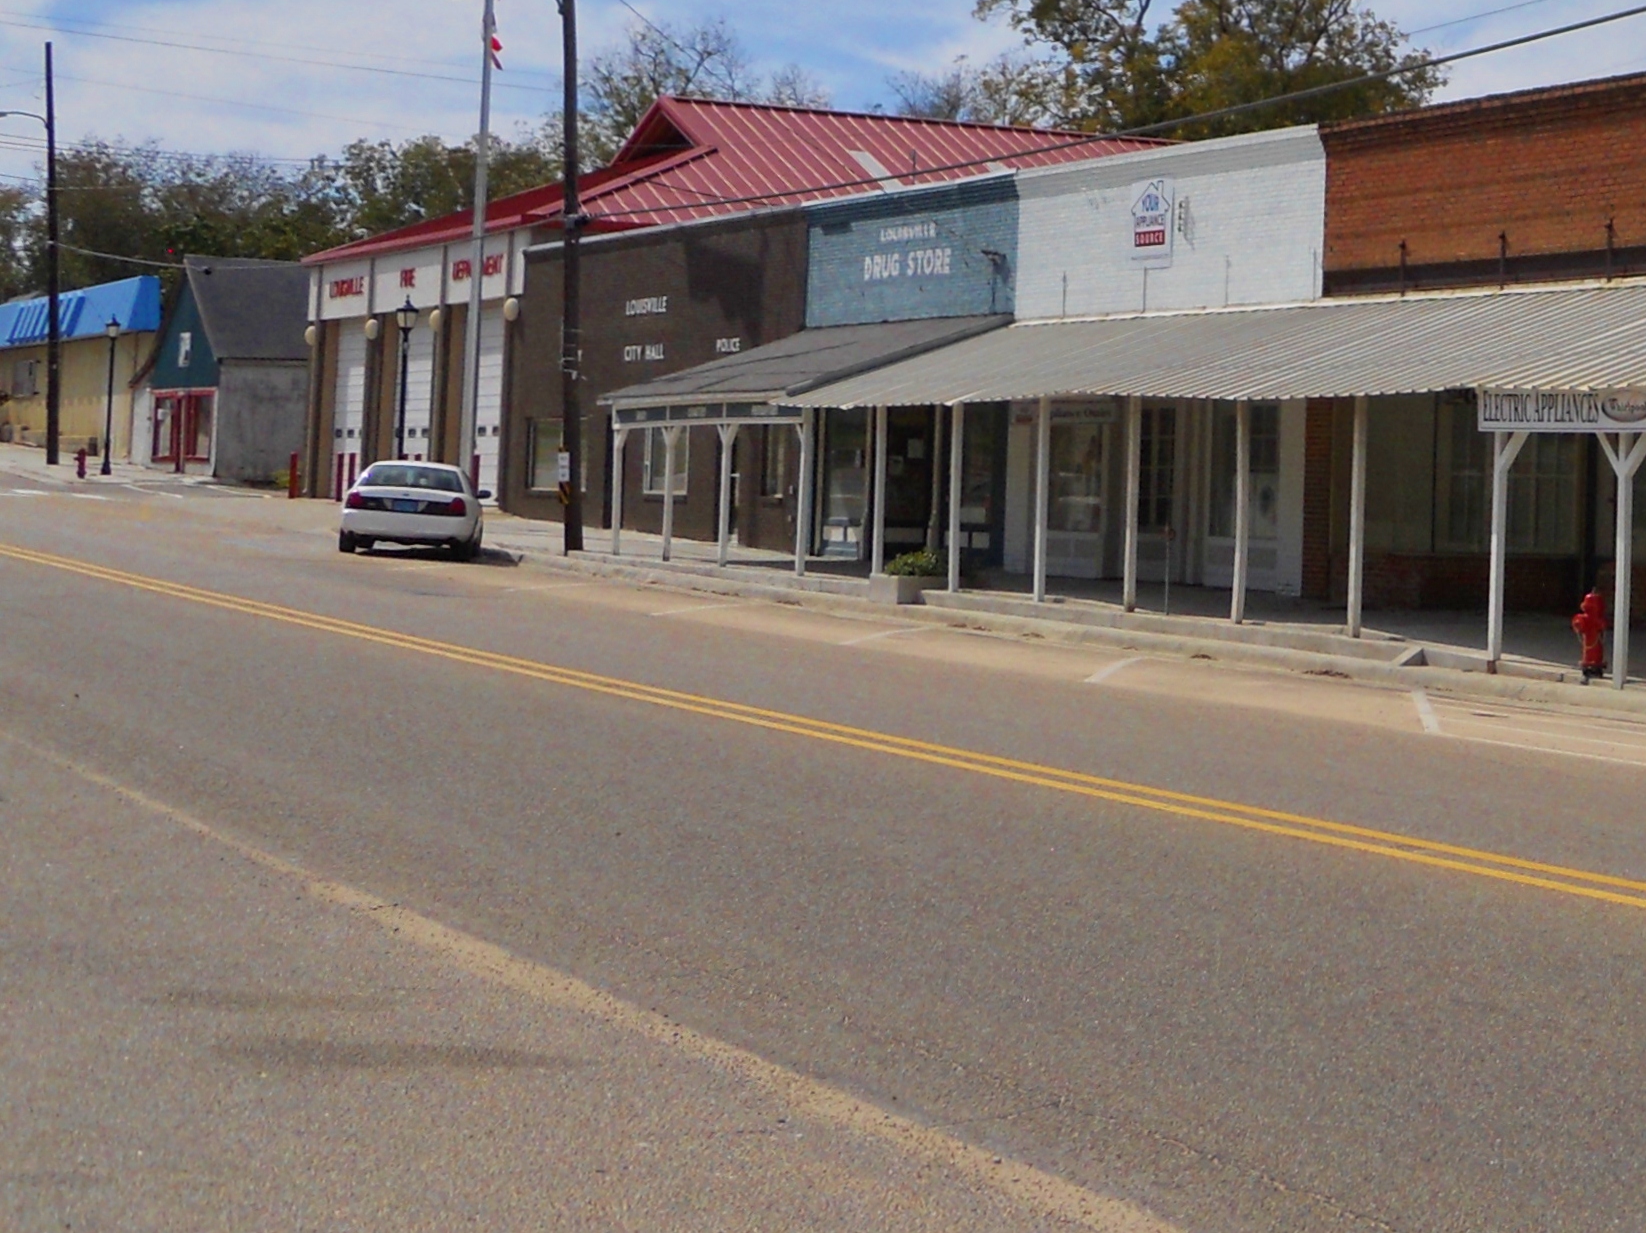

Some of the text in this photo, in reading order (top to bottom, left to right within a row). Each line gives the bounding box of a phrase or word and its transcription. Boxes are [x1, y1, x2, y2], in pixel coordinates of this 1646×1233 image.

[1142, 193, 1159, 212] YOUR
[1135, 231, 1164, 245] SOURCE
[863, 248, 952, 281] DRUG STORE
[625, 296, 668, 316] LOUISVILLE
[624, 343, 664, 362] CITY HALL
[716, 337, 741, 353] POLICE
[1482, 390, 1599, 424] ELECTRIC APPLIANCES
